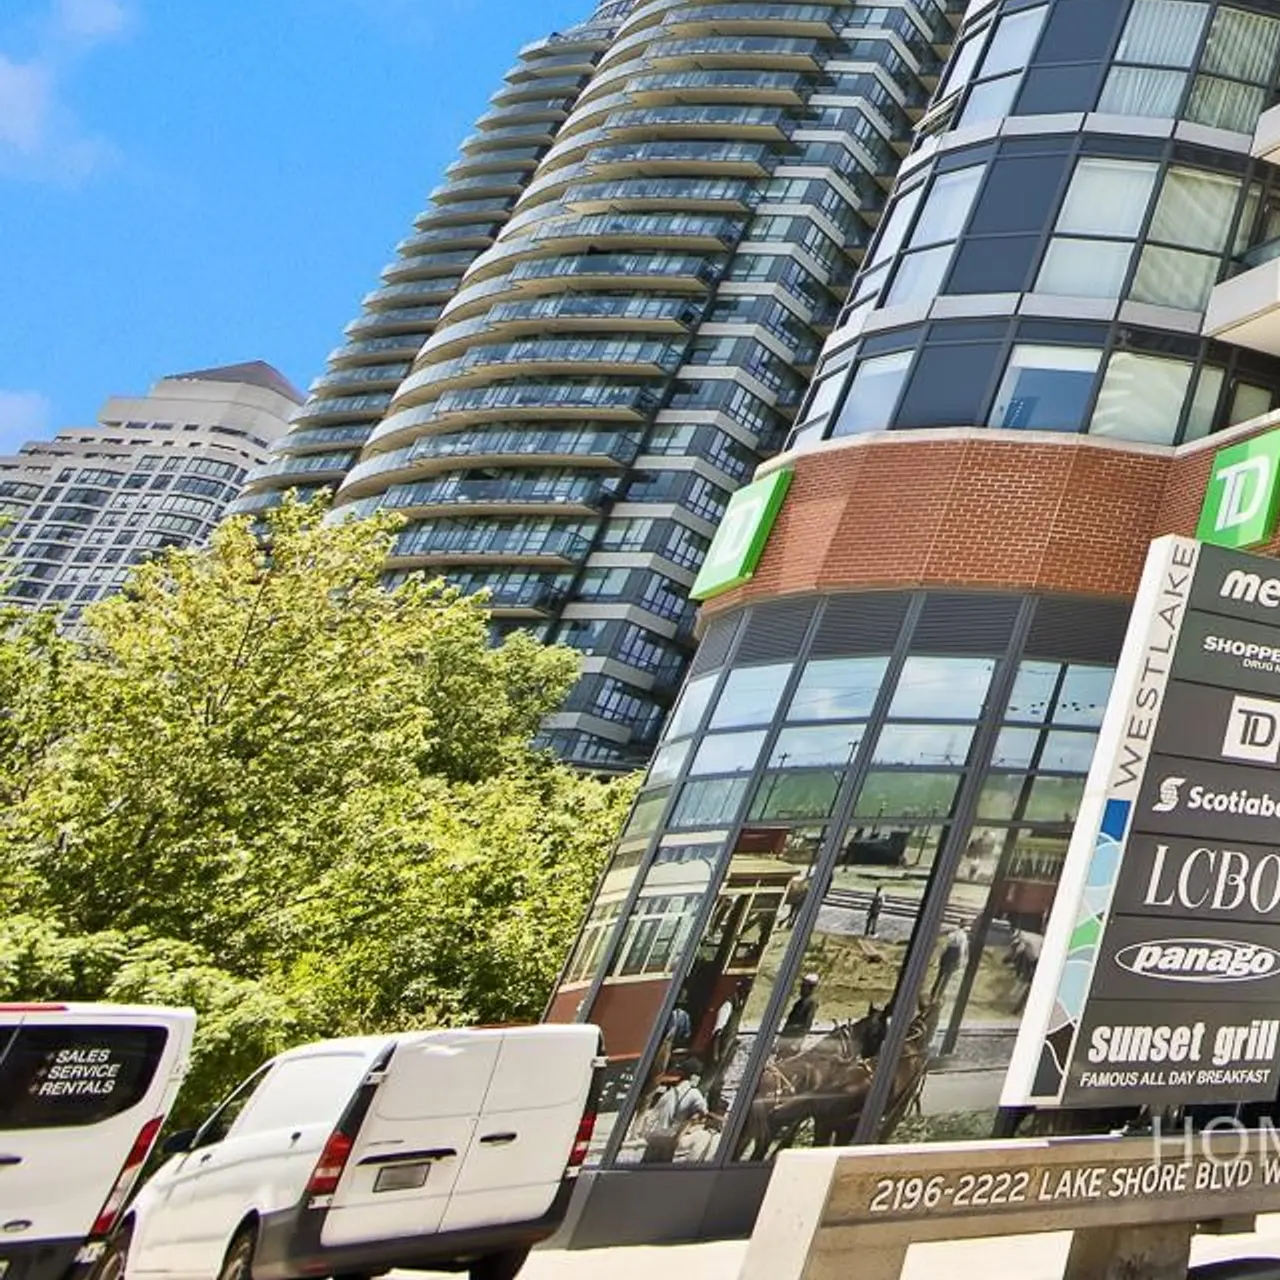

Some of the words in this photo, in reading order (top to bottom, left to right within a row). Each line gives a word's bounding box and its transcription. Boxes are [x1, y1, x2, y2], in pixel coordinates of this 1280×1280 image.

[1214, 455, 1270, 532] TD
[1113, 544, 1196, 788] WESTLAKE
[1243, 658, 1274, 672] DRUG
[1237, 708, 1278, 747] TD
[1132, 942, 1276, 978] panago
[56, 1049, 111, 1064] SALES
[1088, 1022, 1204, 1063] sunset
[1211, 1019, 1280, 1065] grill
[39, 1079, 116, 1096] RENTALS
[48, 1063, 121, 1079] SERVICE
[1080, 1071, 1139, 1088] FAMOUS
[1140, 1071, 1166, 1086] ALL
[1168, 1070, 1196, 1086] DAY
[1196, 1068, 1271, 1085] BREAKFAST
[869, 1171, 1028, 1213] 2196-2222
[1038, 1167, 1103, 1201] LAKE
[1107, 1163, 1187, 1199] SHORE
[1194, 1158, 1253, 1191] BLVD
